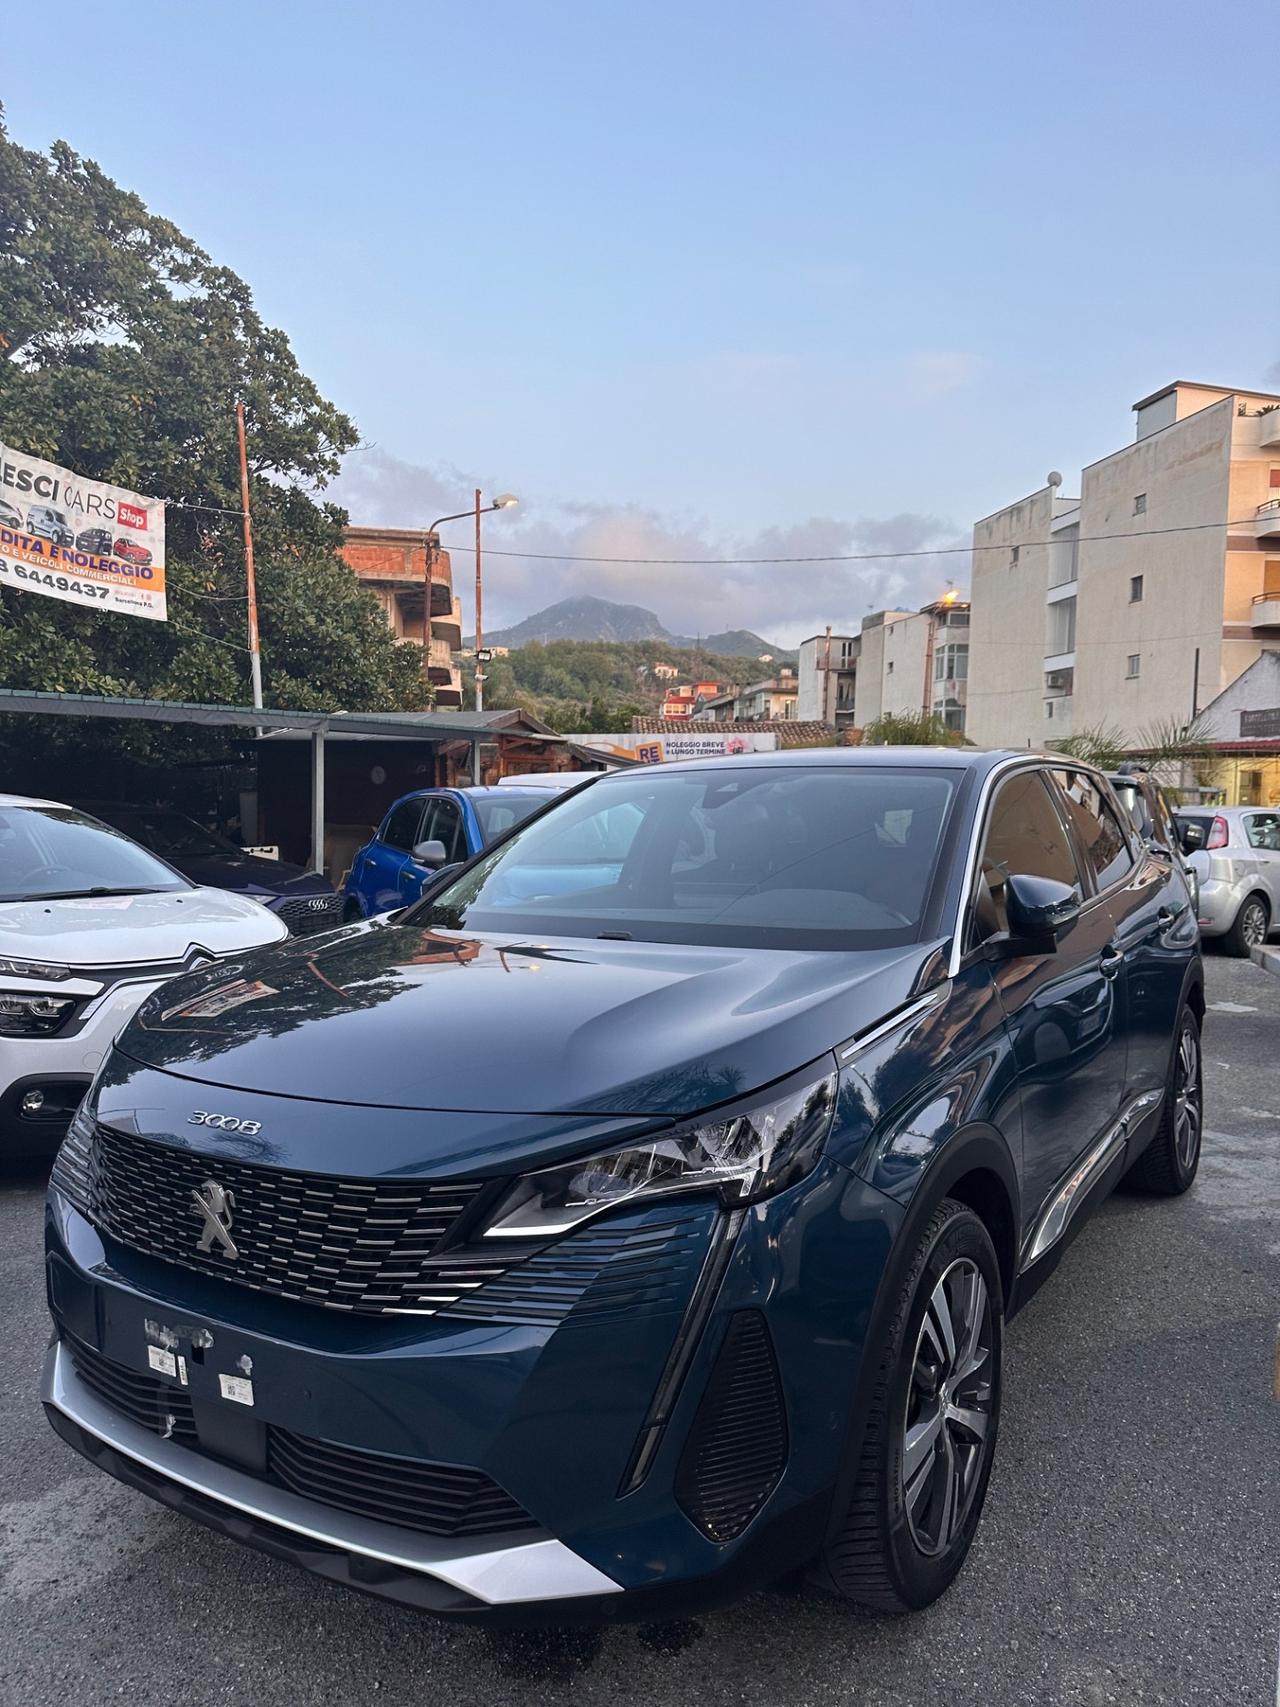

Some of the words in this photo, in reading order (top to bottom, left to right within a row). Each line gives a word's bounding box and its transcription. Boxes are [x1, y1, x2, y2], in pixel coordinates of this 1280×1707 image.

[0, 458, 59, 501] ESCI
[64, 486, 115, 519] CARS
[119, 508, 144, 527] Stop
[1, 530, 44, 554] DITA
[50, 545, 60, 559] E
[62, 549, 153, 579] NOLEGGIO
[22, 551, 63, 570] VEICOLI
[66, 563, 137, 586] COMMERCIALI
[14, 564, 110, 599] 6449437
[188, 1110, 262, 1135] 3008
